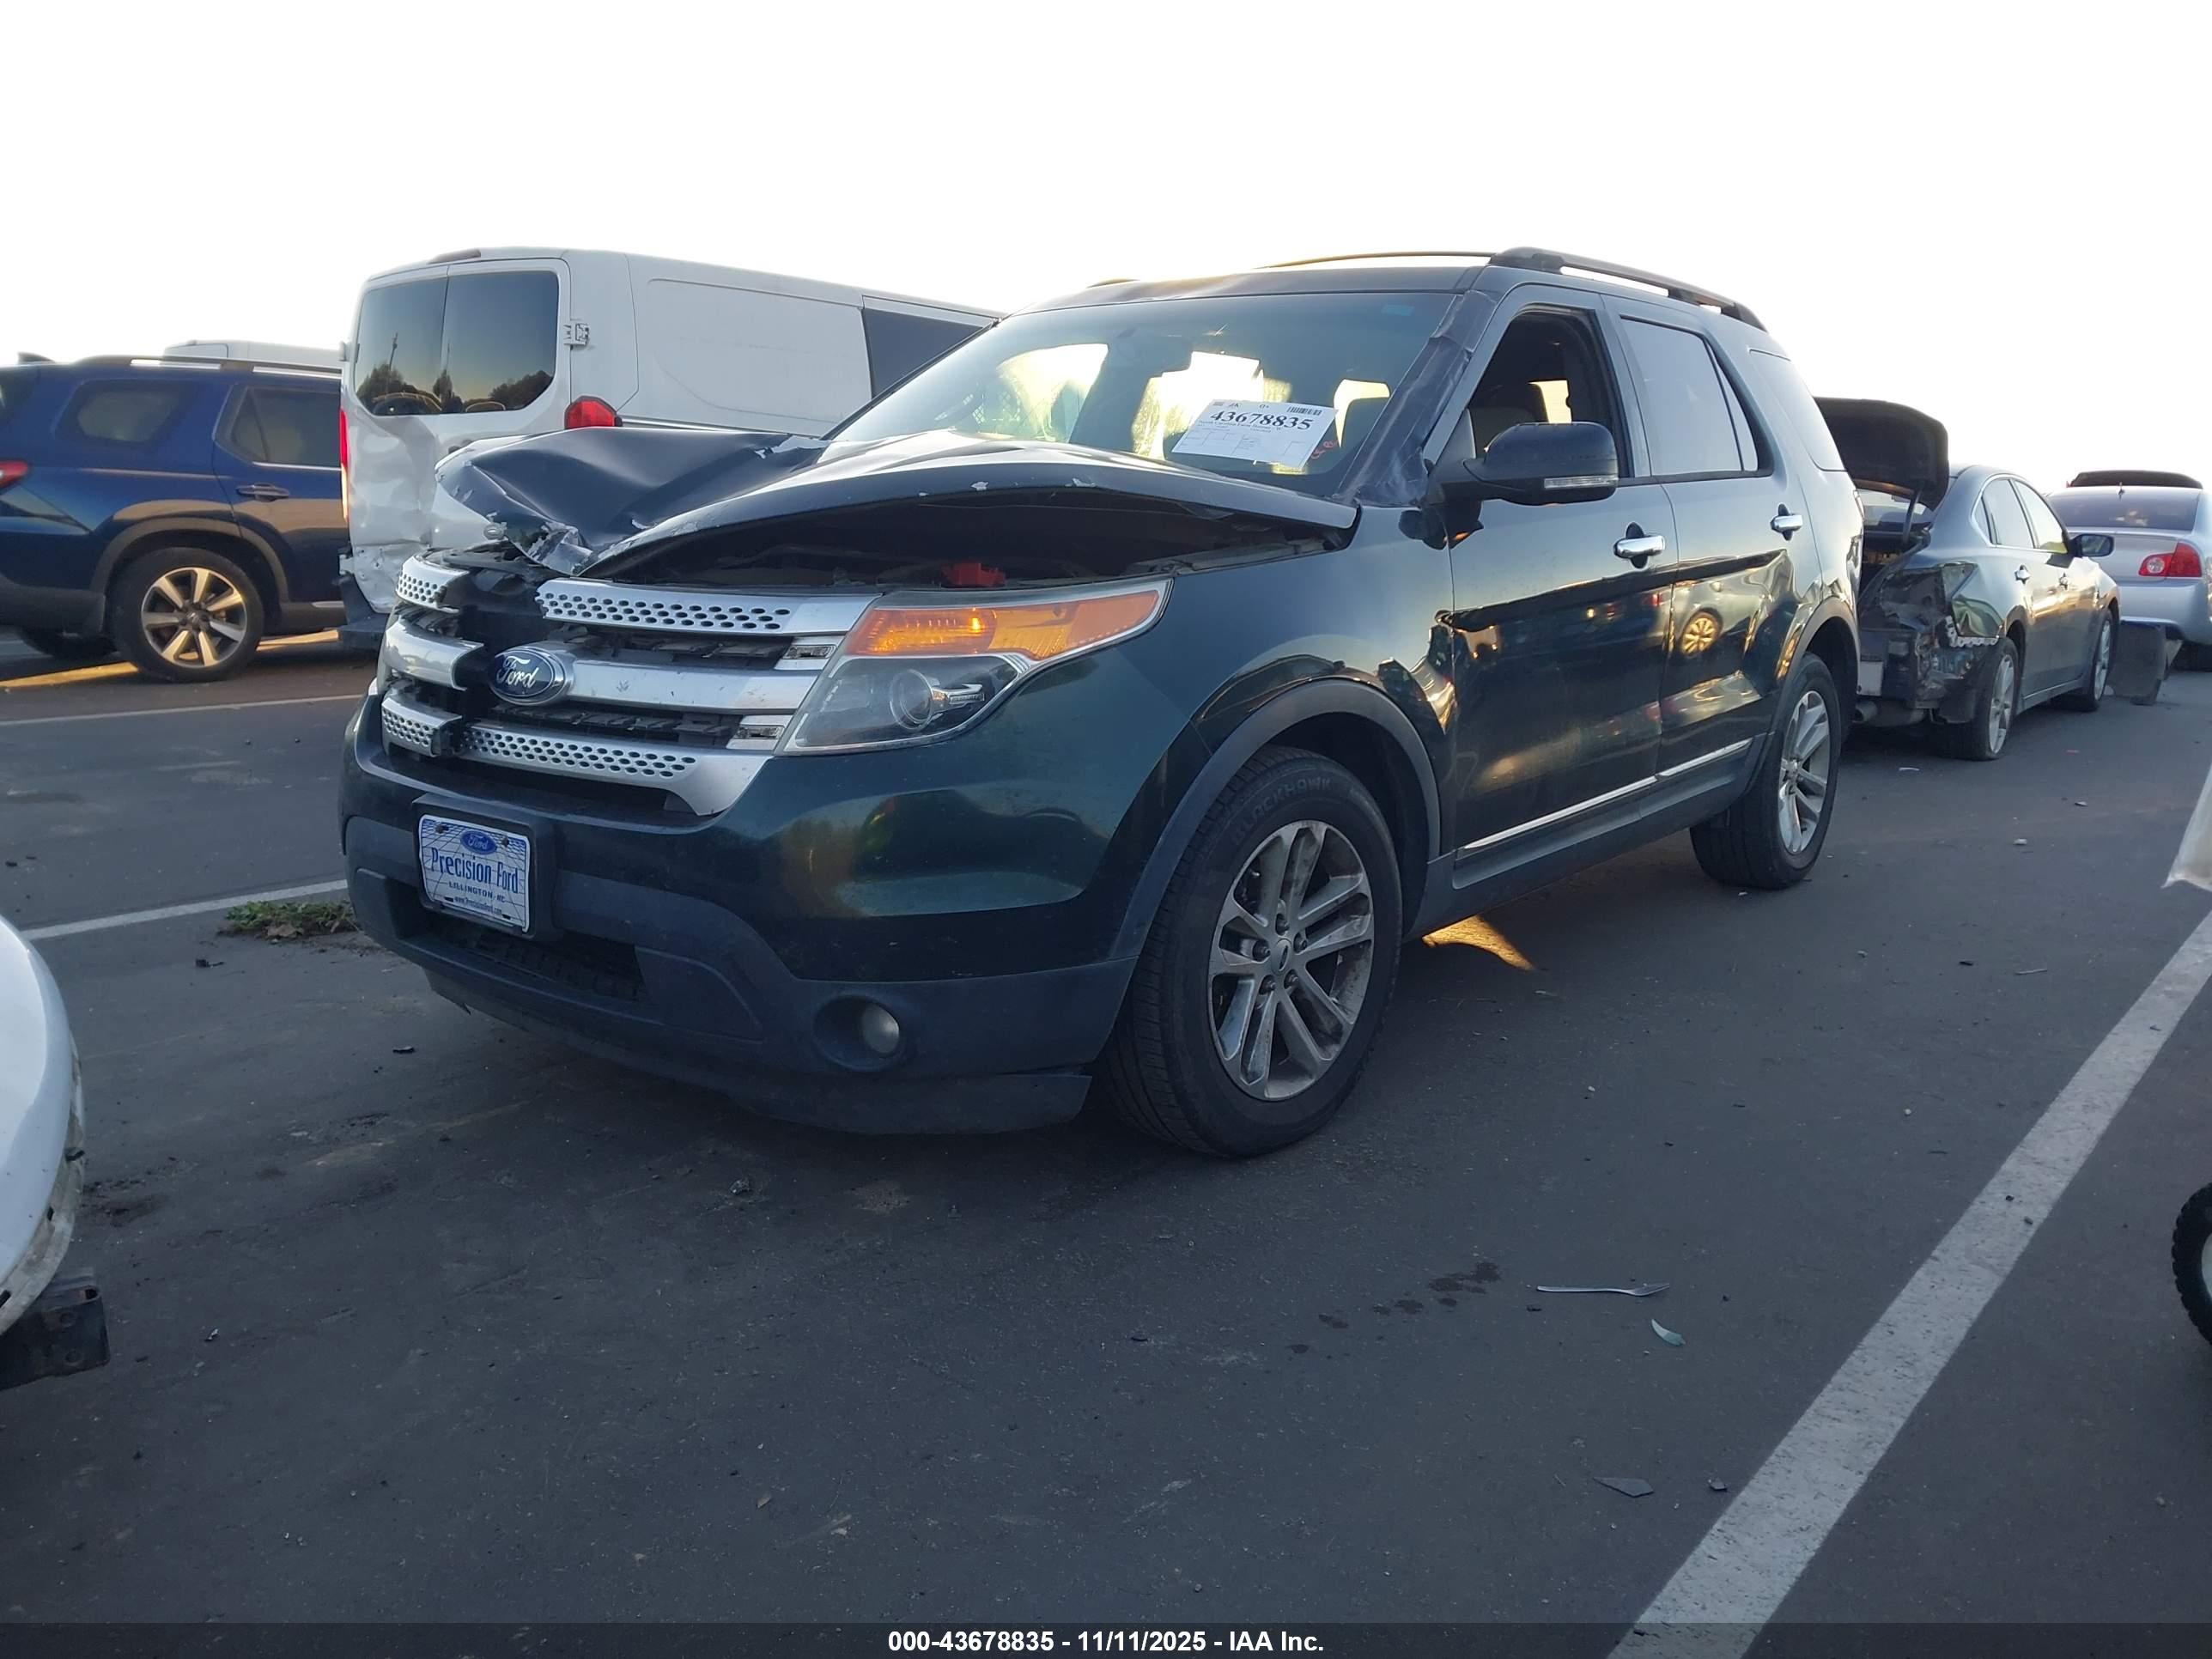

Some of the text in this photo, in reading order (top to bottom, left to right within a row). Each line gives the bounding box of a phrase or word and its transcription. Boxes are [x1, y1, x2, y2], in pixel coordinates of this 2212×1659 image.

[1210, 410, 1314, 430] 43678835
[495, 655, 539, 688] Ford
[468, 834, 489, 850] Ford
[430, 847, 519, 894] Precision Ford
